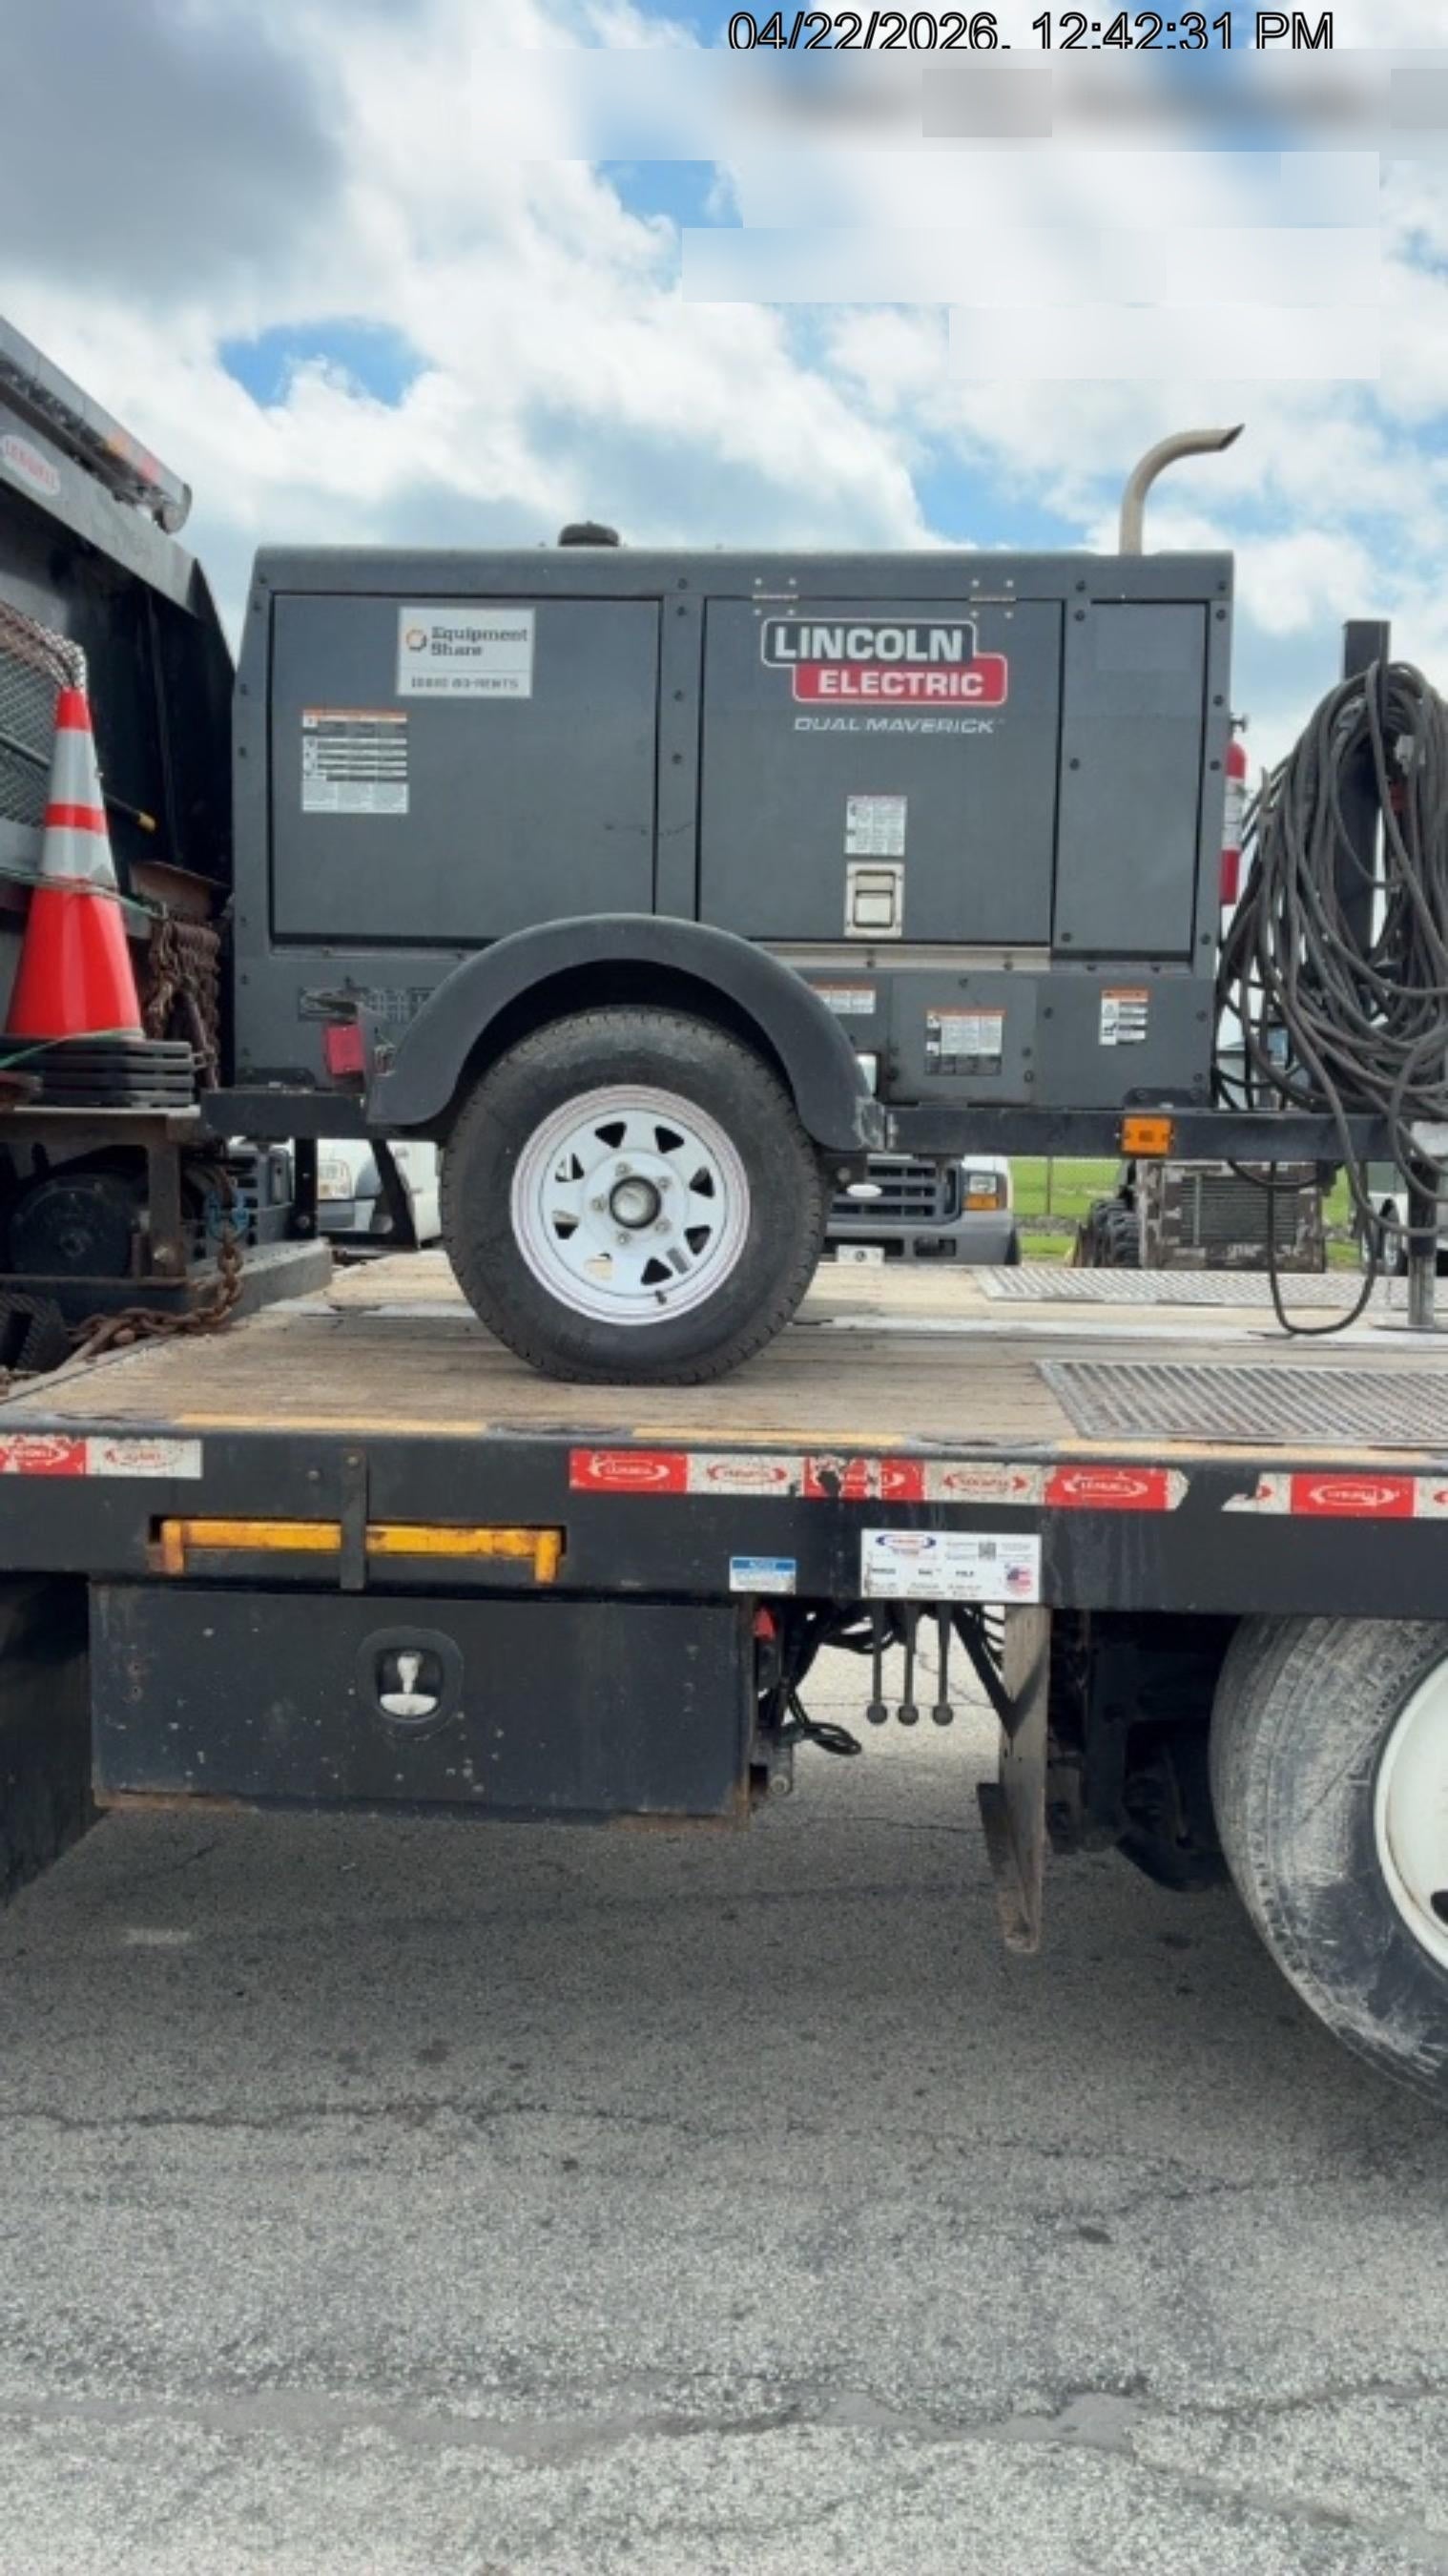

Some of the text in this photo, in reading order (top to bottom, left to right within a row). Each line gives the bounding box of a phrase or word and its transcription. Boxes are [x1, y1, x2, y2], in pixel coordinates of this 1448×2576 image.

[430, 626, 528, 643] Equipment
[430, 642, 483, 656] Share
[774, 626, 963, 662] LINCOLN
[817, 668, 985, 696] ELECTRIC
[794, 717, 995, 734] DUAL MAVERICK
